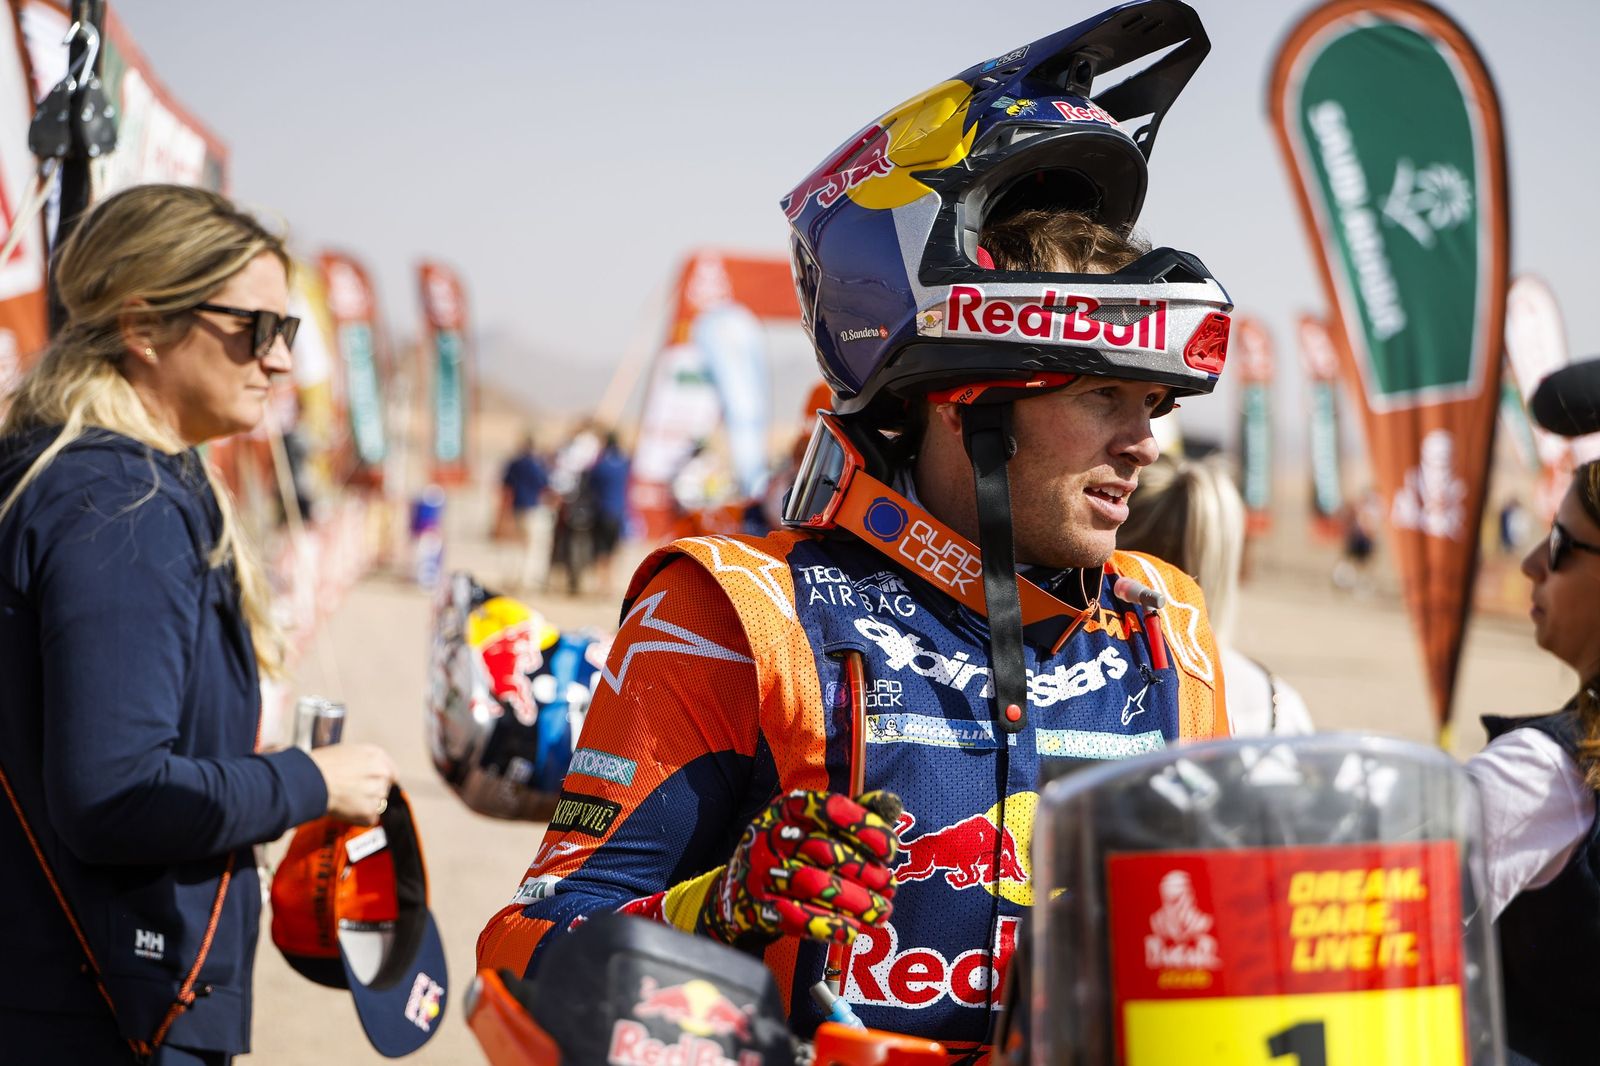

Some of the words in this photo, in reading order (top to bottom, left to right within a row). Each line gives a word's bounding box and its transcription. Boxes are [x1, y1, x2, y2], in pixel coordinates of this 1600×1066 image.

[946, 284, 1057, 340] Red
[1062, 293, 1168, 353] Bull
[899, 536, 976, 596] LOCK
[910, 519, 982, 578] QUAD
[903, 723, 993, 740] MICHELIN
[823, 915, 1031, 1009] Red
